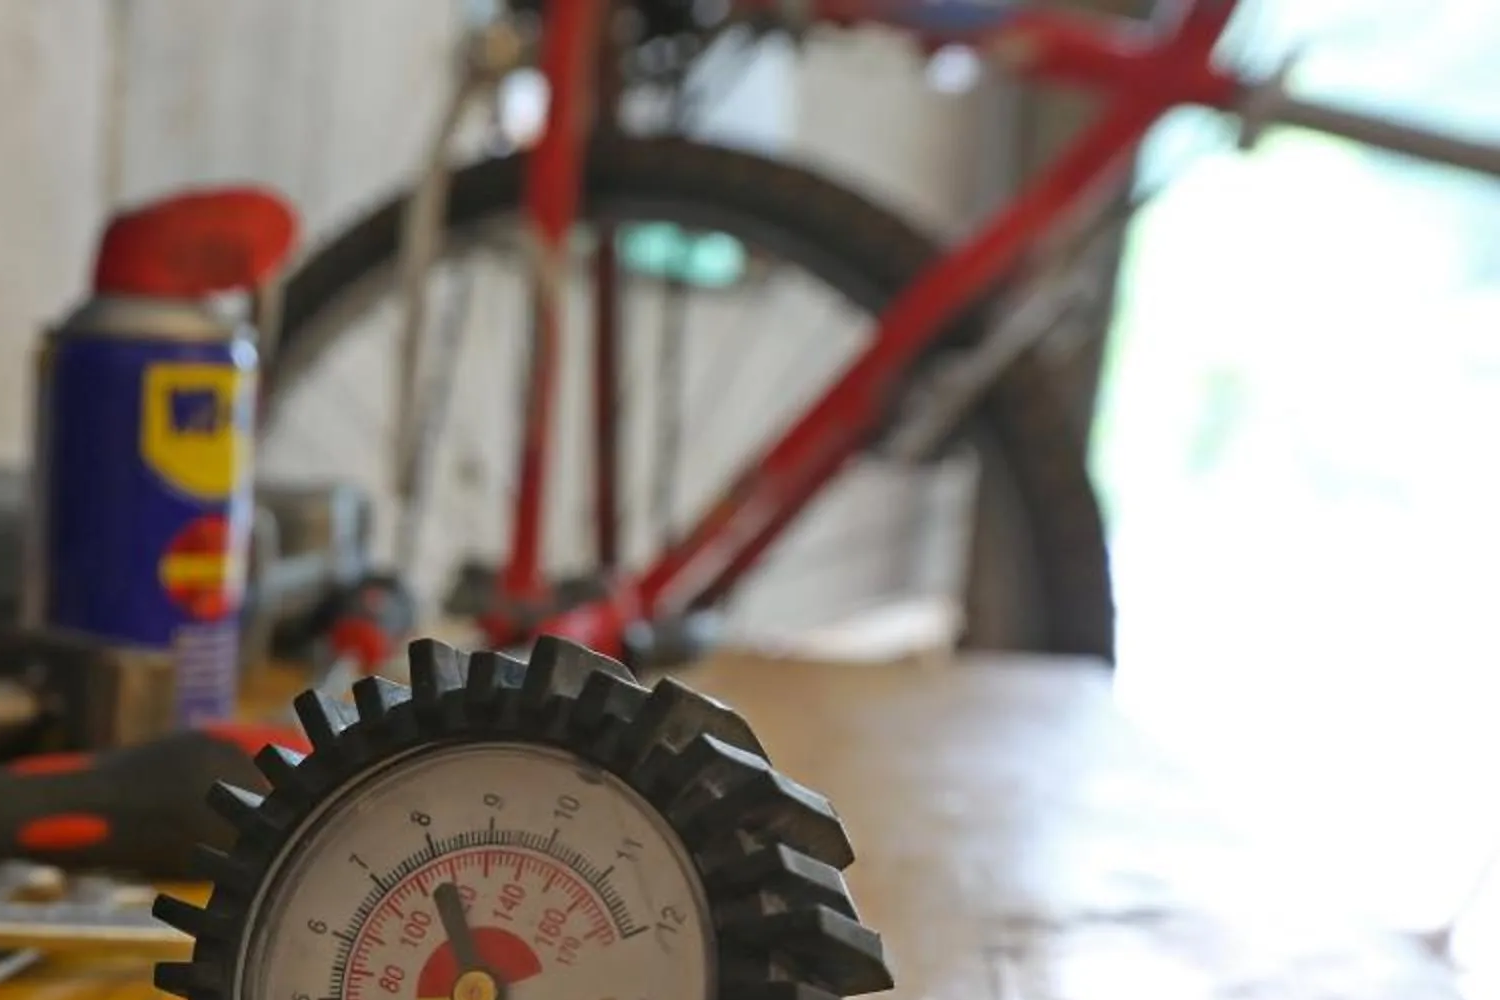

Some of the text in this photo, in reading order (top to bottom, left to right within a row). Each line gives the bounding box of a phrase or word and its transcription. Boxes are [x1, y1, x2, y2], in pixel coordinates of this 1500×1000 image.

[484, 793, 503, 810] 9
[554, 795, 580, 819] 10
[410, 810, 431, 826] 8
[349, 853, 369, 870] 7
[616, 838, 643, 862] 11
[493, 884, 525, 921] 140
[307, 918, 327, 935] 6
[401, 911, 431, 947] 100
[534, 908, 566, 946] 160
[656, 906, 686, 933] 12
[379, 965, 404, 994] 80
